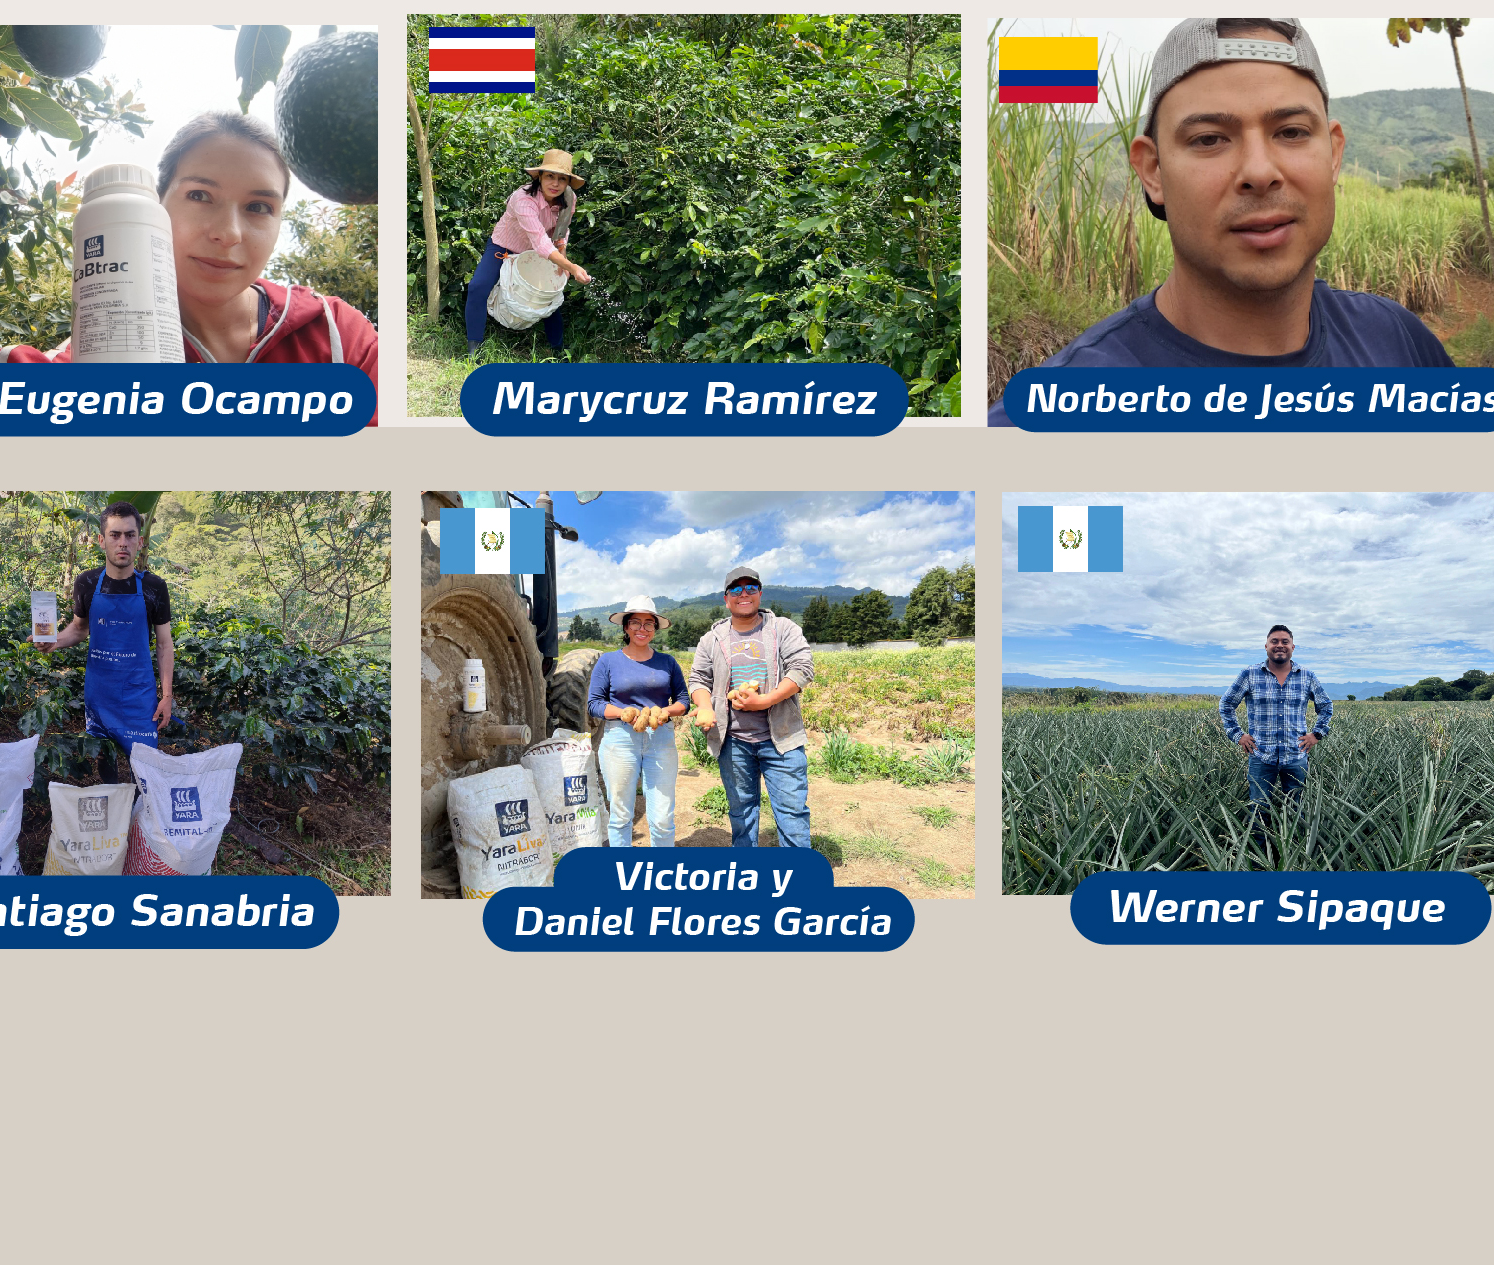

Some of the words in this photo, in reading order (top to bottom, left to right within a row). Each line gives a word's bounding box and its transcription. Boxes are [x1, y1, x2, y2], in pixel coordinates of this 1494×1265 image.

[73, 261, 129, 283] CaBtrac
[175, 811, 199, 819] YARA
[79, 821, 106, 829] YARA
[503, 823, 528, 833] YARA
